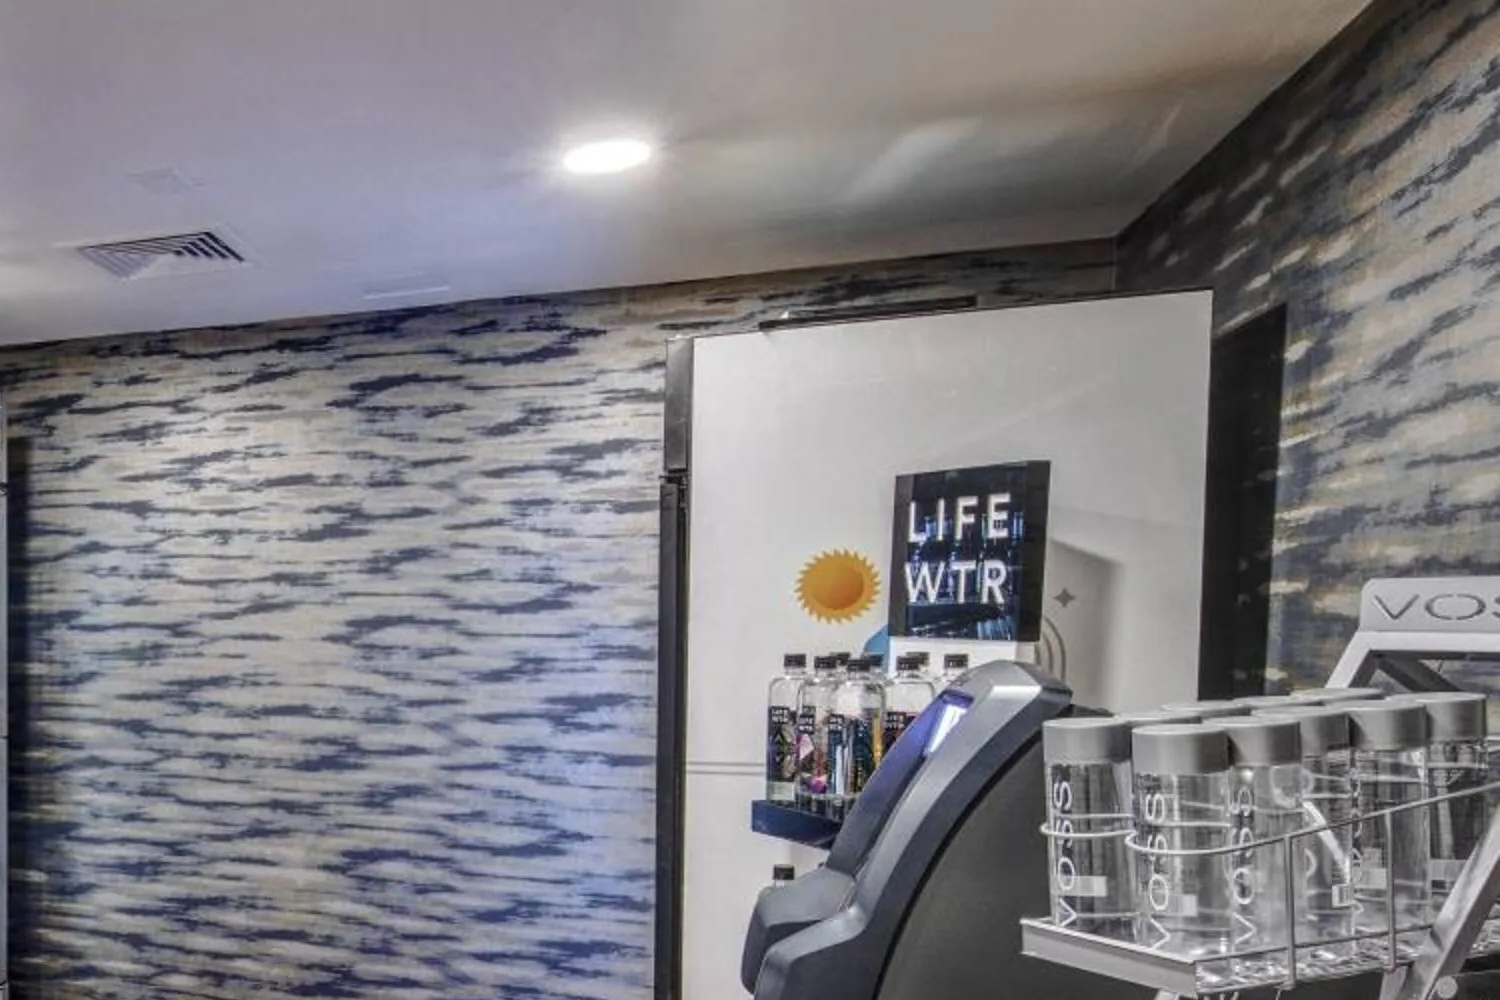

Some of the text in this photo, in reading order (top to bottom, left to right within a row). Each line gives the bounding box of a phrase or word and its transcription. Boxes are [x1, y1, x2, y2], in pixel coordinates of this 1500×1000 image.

[907, 493, 1011, 543] LIFE
[904, 559, 1008, 604] WTR
[1373, 592, 1500, 620] VO
[1053, 781, 1077, 928] VOSS
[1145, 792, 1171, 950] VOSS
